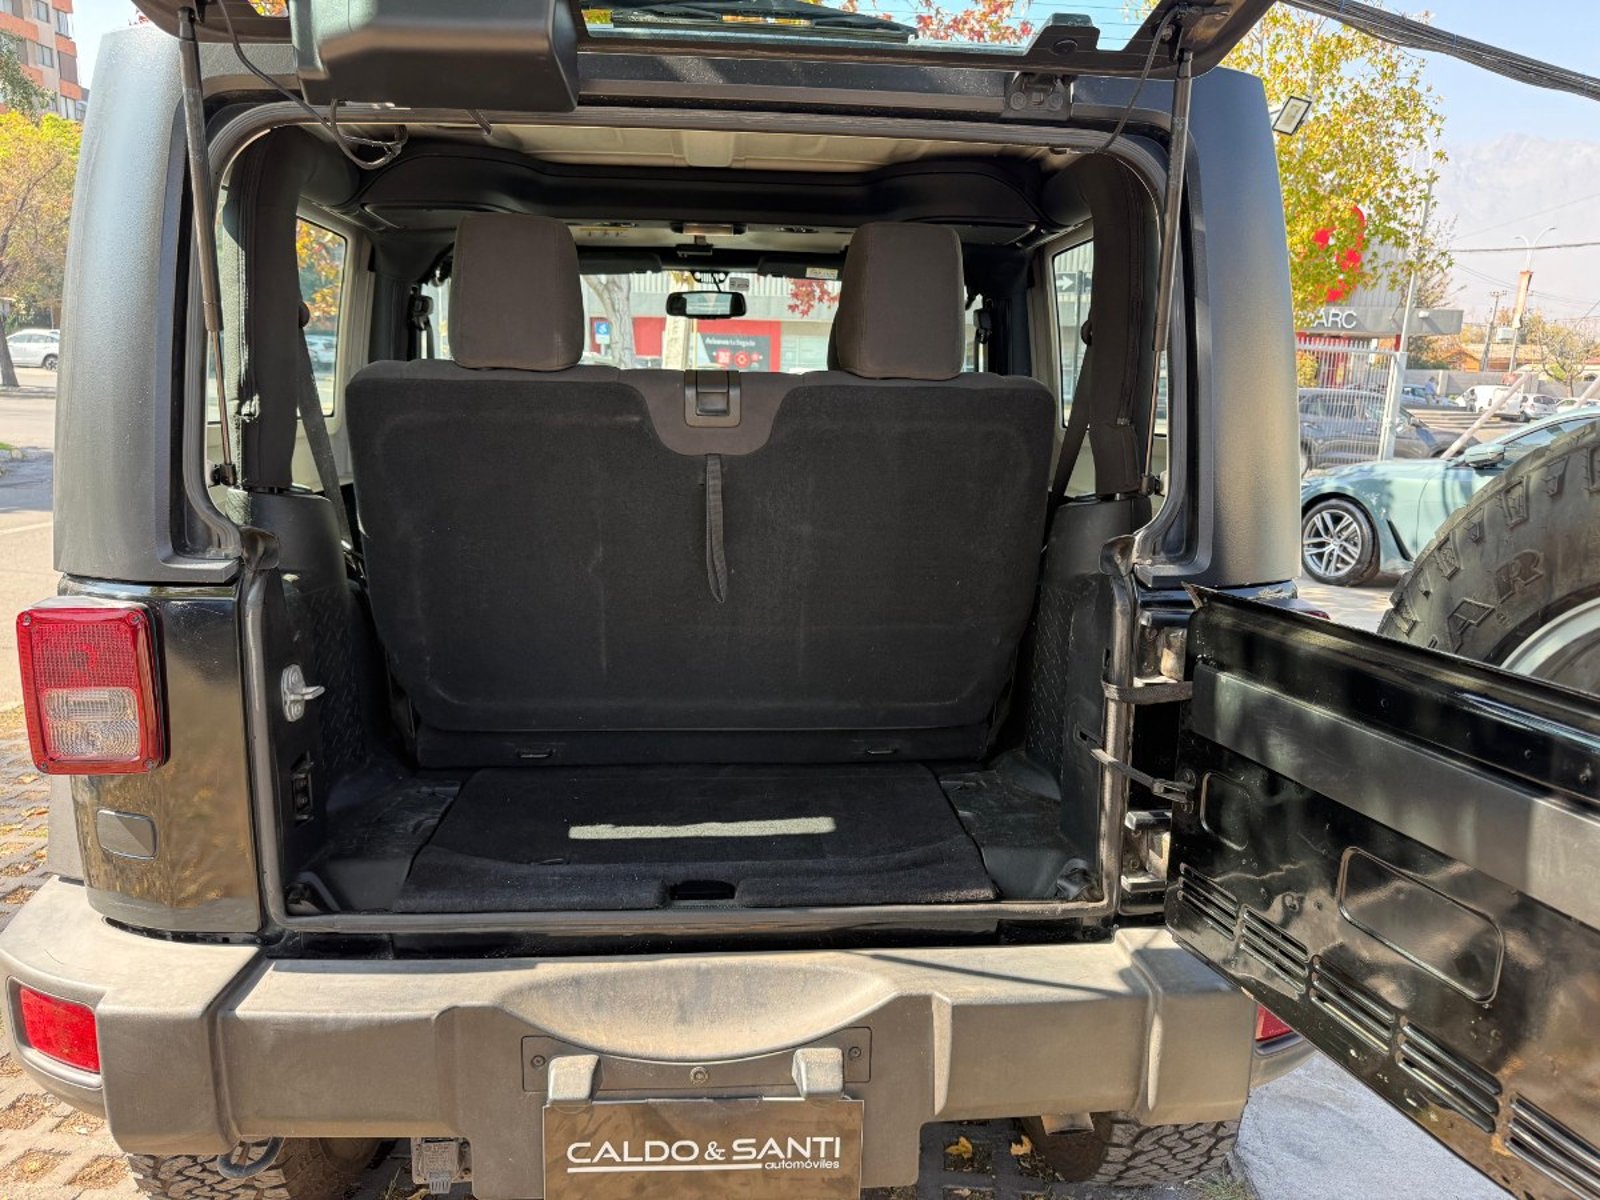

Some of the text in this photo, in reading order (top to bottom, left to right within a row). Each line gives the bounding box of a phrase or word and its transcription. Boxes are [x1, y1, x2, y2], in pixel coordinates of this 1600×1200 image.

[1308, 308, 1357, 328] ARC
[566, 1136, 841, 1163] CALDO & SANTI
[764, 1159, 840, 1170] automóviles
